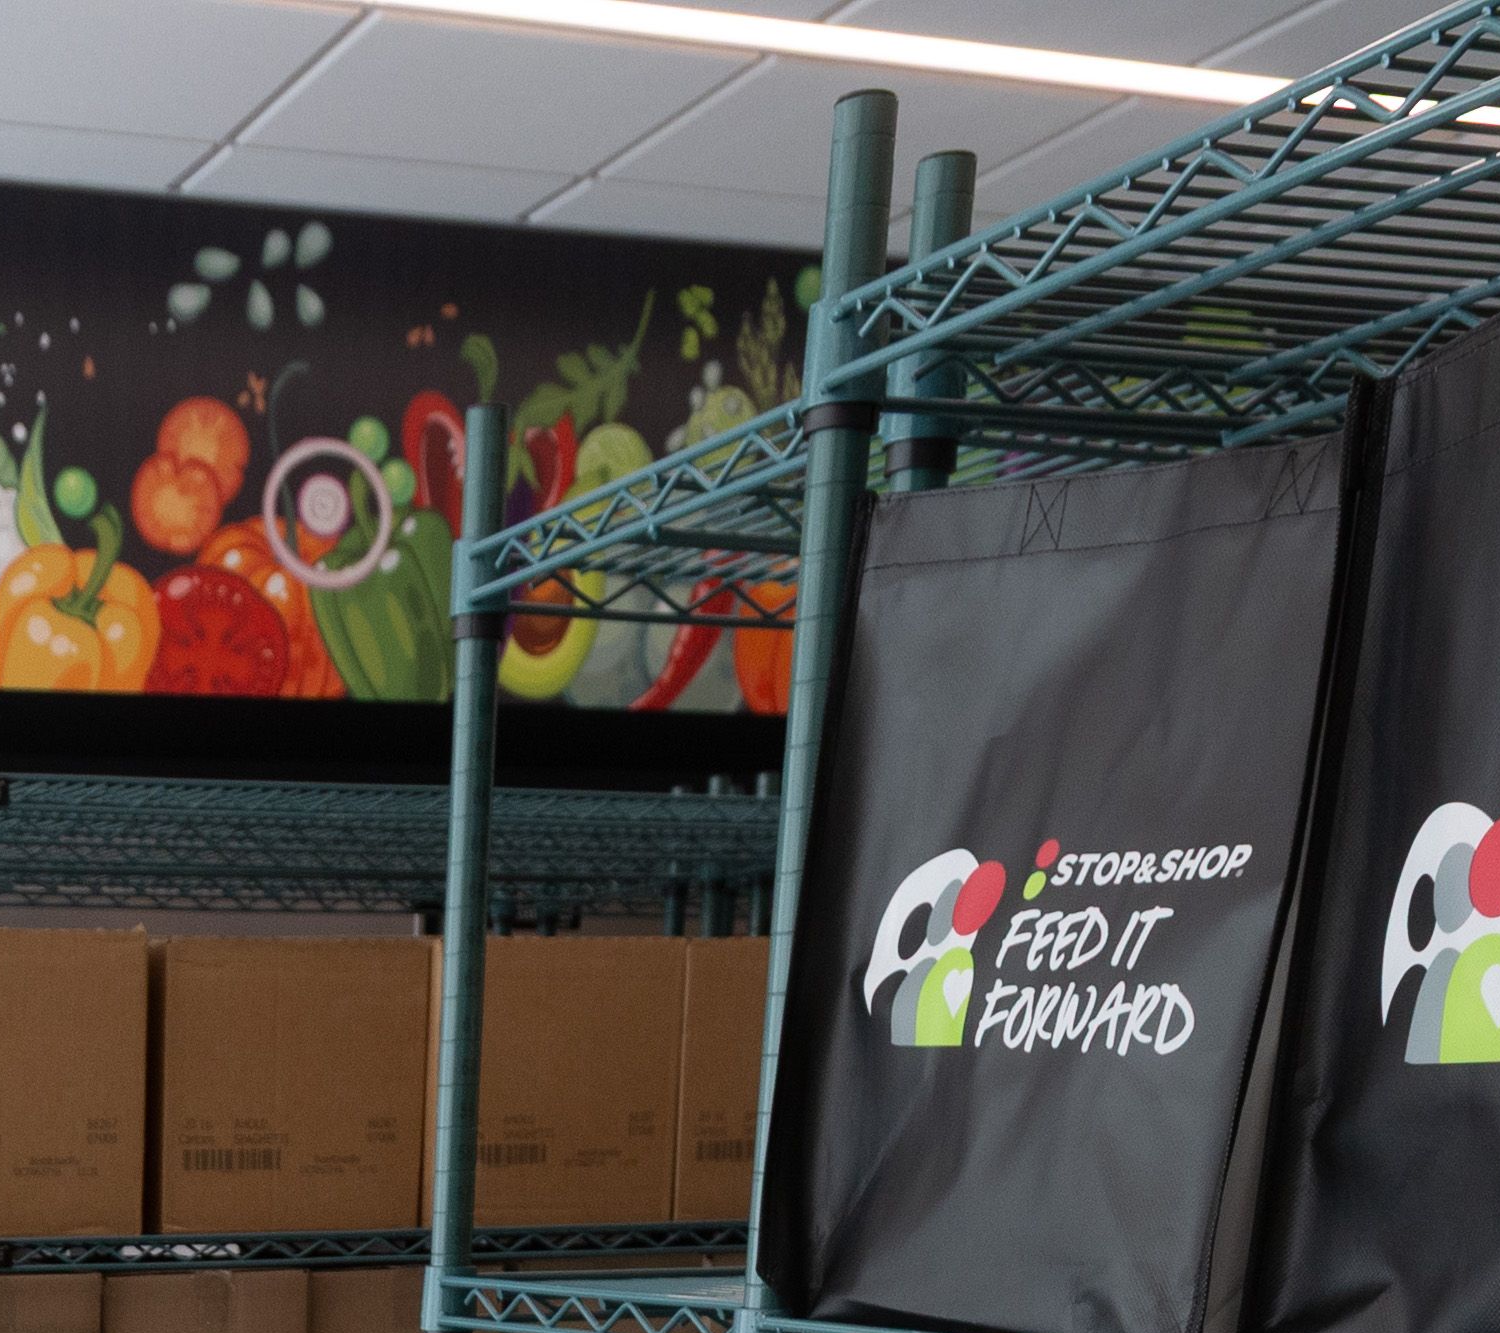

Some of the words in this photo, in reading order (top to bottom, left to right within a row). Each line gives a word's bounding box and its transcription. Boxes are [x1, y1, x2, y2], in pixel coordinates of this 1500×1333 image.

[1051, 844, 1252, 886] STOP&SHOP
[995, 906, 1109, 971] FEED
[1111, 906, 1174, 970] IT
[974, 978, 1195, 1056] FORWARD
